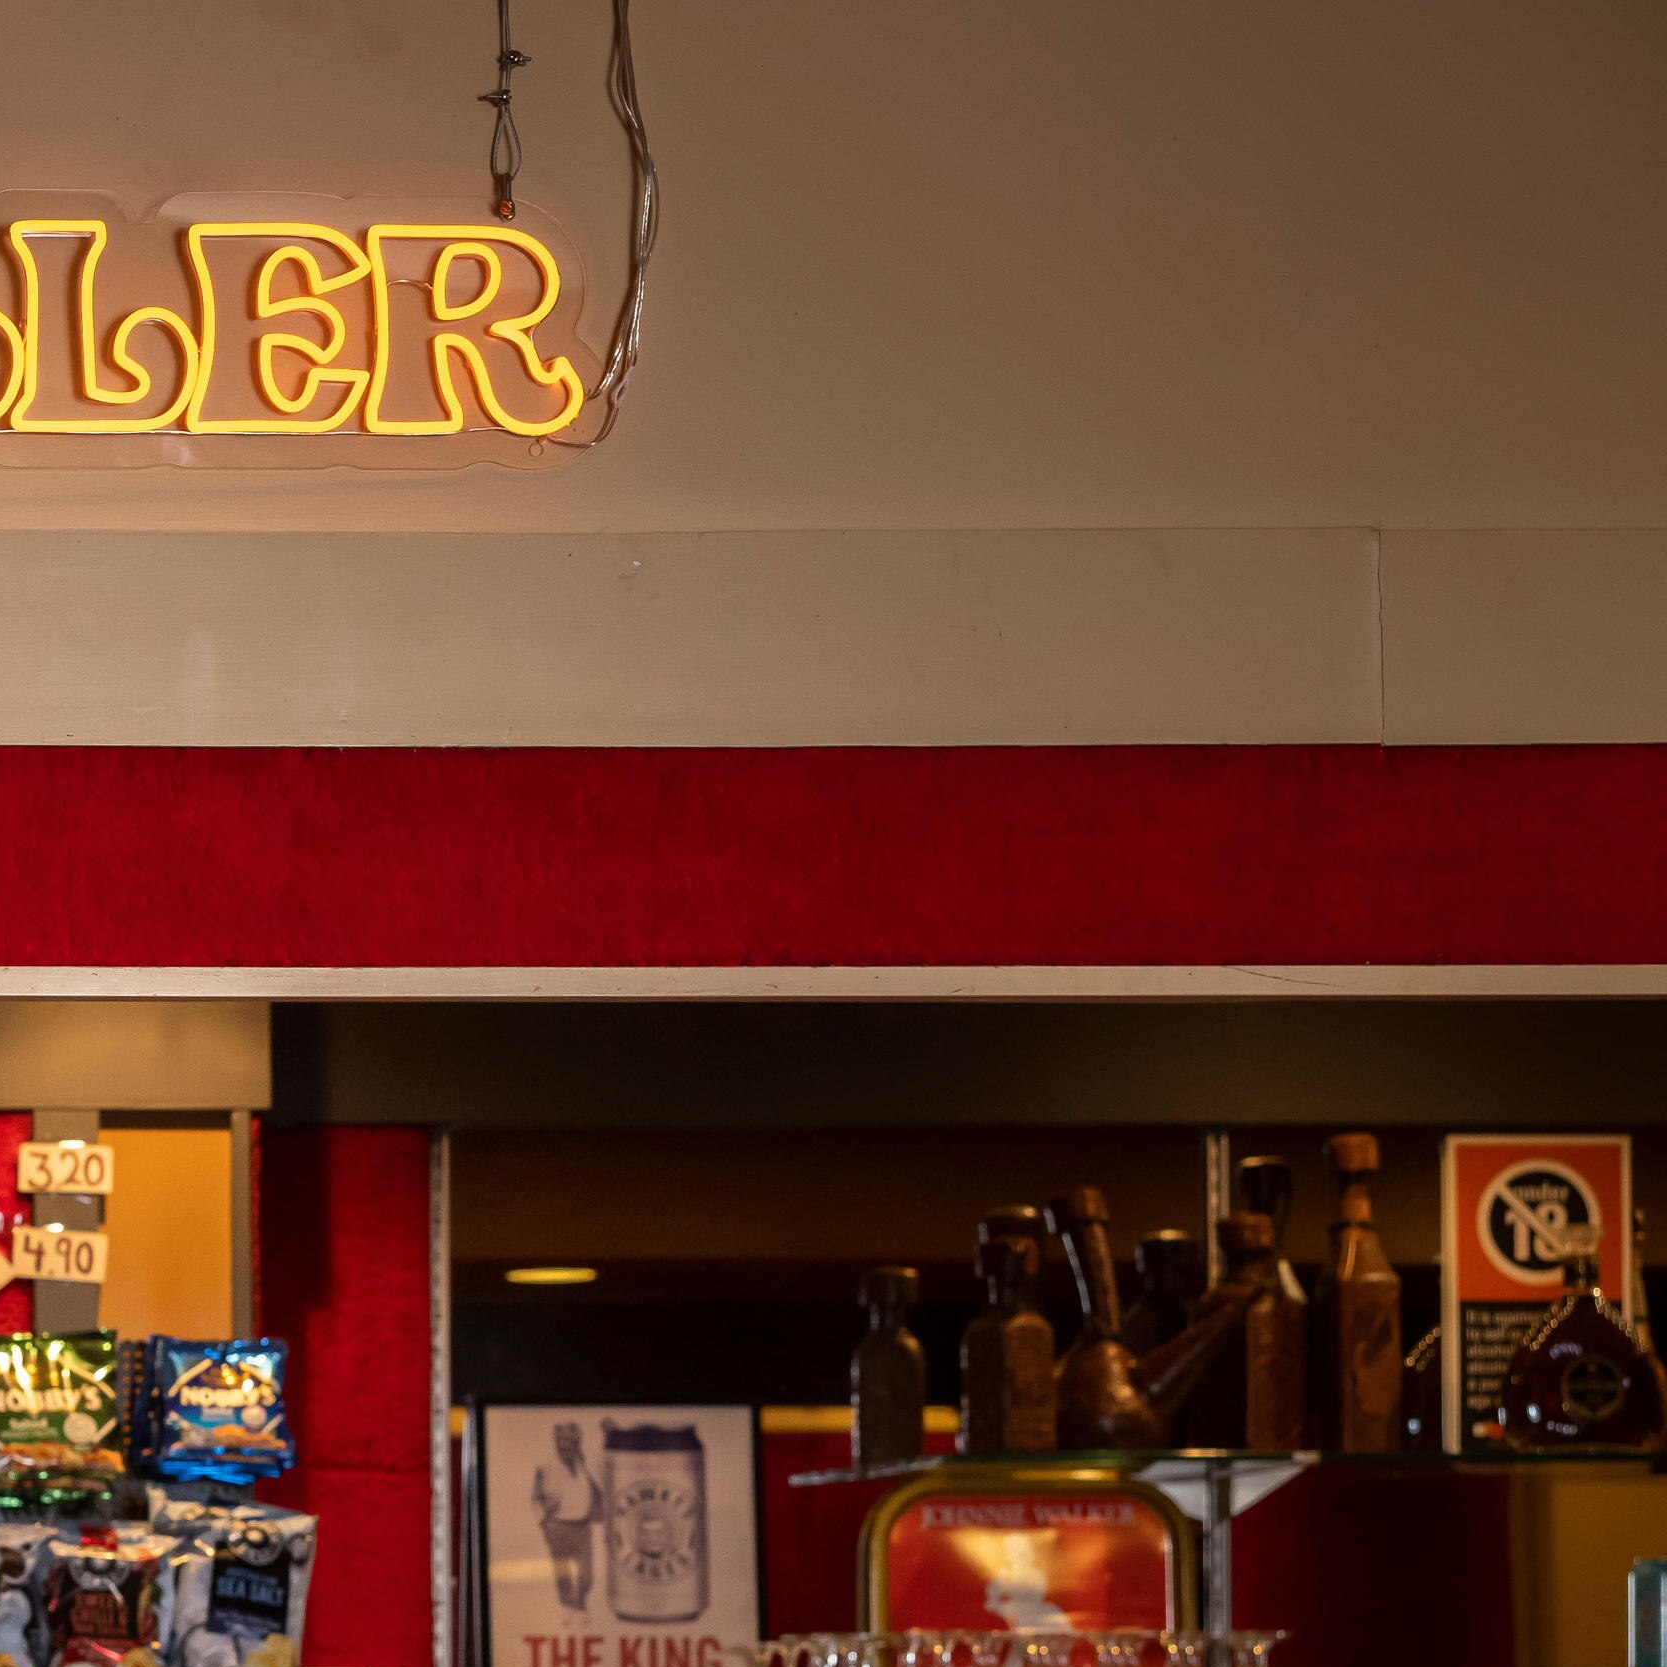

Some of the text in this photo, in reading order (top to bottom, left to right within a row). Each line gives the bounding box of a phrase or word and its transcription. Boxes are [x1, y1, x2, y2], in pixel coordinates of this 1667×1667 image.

[1504, 1200, 1568, 1263] 18
[23, 1234, 94, 1275] 4.90
[1033, 1502, 1134, 1525] WALKER
